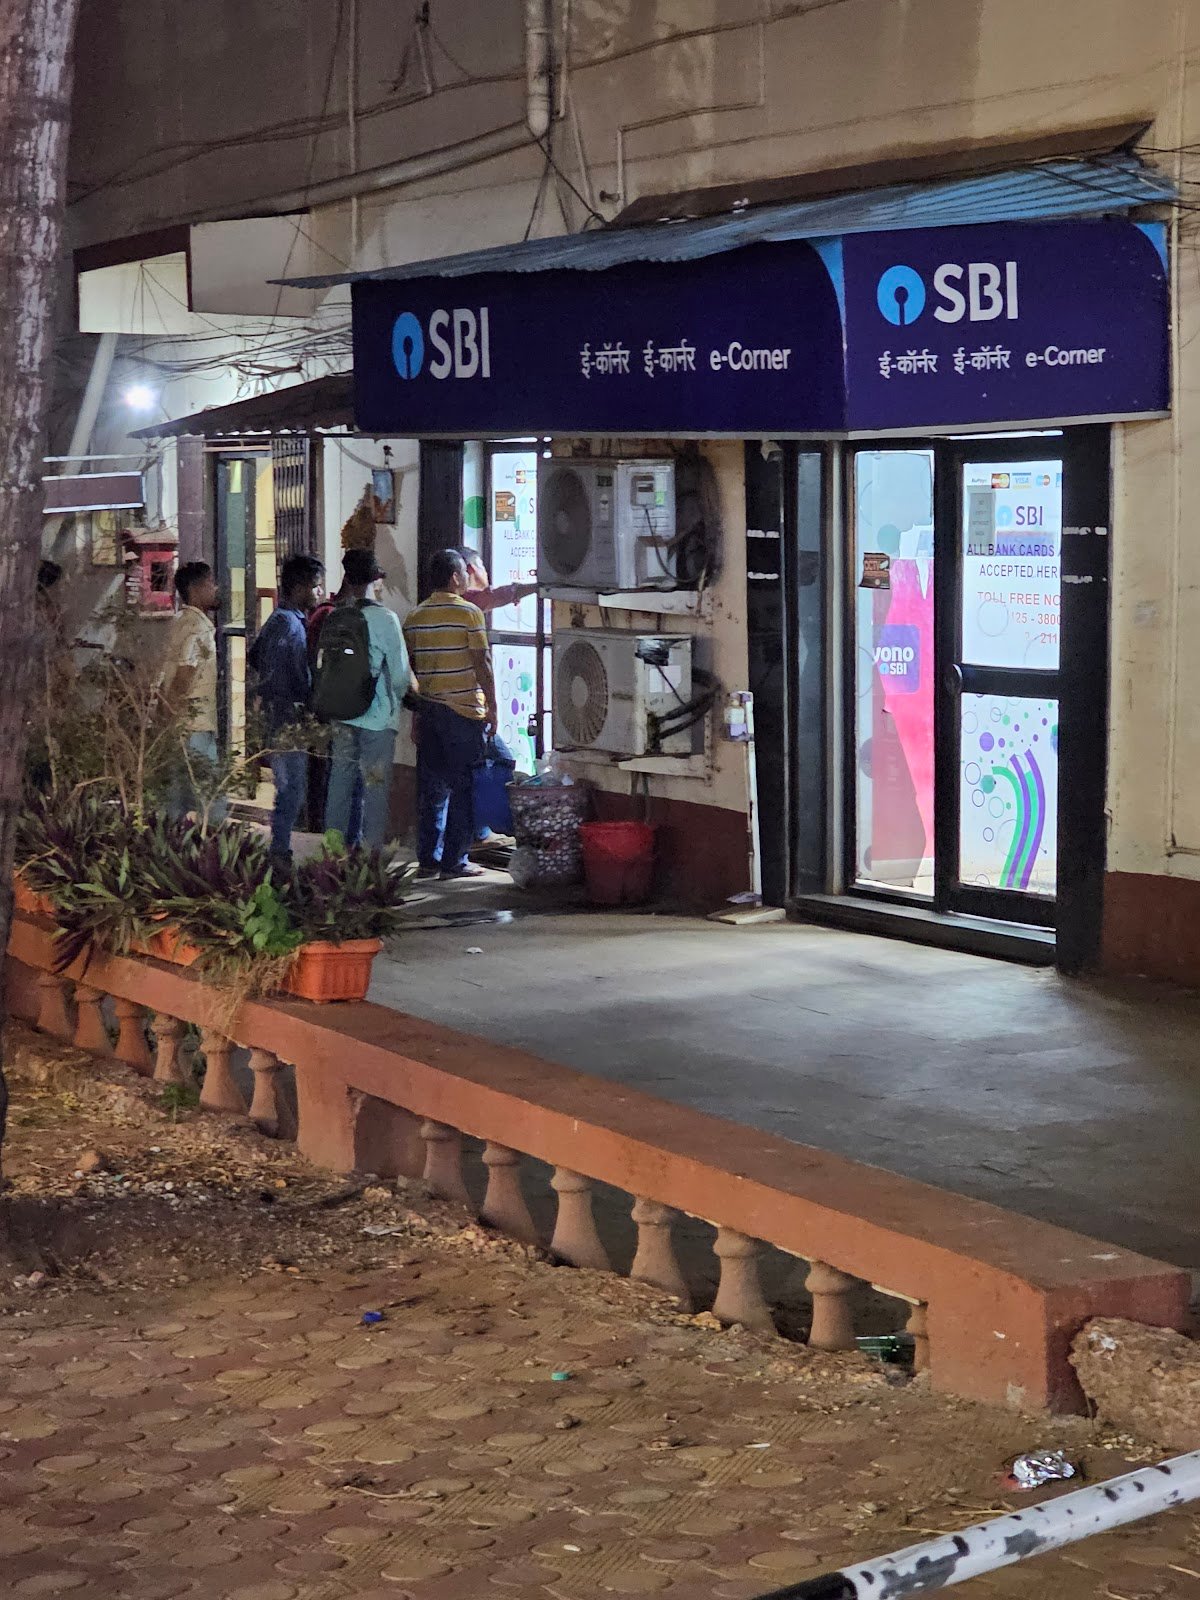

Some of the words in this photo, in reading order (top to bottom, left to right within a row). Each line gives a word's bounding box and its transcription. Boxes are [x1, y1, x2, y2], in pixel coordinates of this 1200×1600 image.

[933, 261, 1019, 324] SBI
[428, 306, 491, 380] SBI
[580, 341, 631, 380] ई-कॉर्नर
[709, 341, 792, 372] e-Corner
[878, 348, 938, 379] ई-कॉर्नर
[952, 344, 1012, 375] ई-कॉर्नर
[1025, 345, 1106, 368] e-Corner
[1015, 505, 1043, 526] SBI
[510, 547, 535, 557] ACCEPTE
[967, 543, 985, 556] ALL
[988, 543, 1017, 557] BANK
[1019, 544, 1055, 557] CARDS
[979, 564, 1034, 578] ACCEPTED
[1036, 566, 1058, 579] HER
[977, 591, 1006, 604] TOLL
[1009, 592, 1040, 606] FREE
[873, 646, 915, 666] yono
[889, 662, 908, 675] SBI
